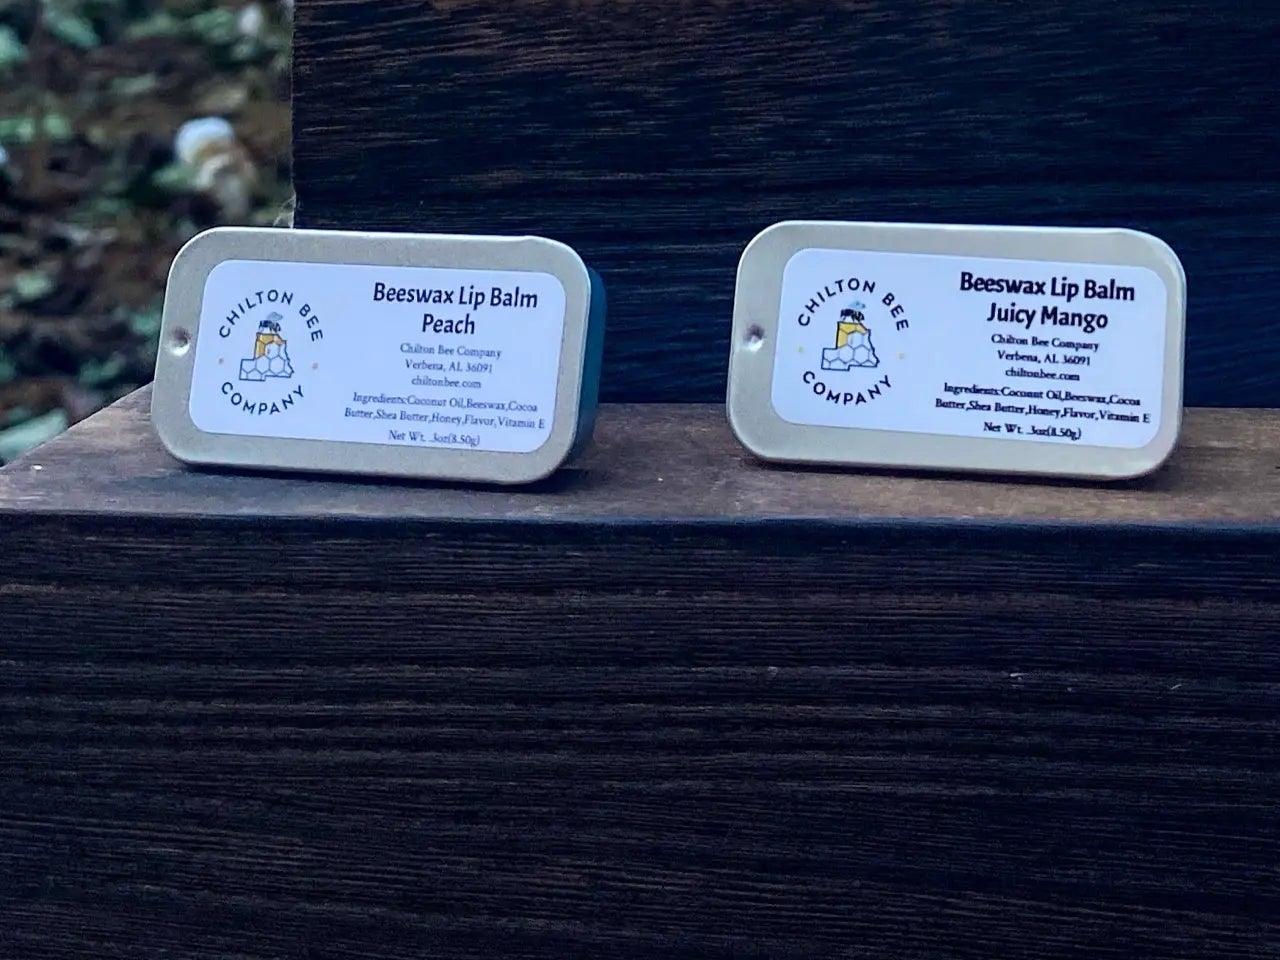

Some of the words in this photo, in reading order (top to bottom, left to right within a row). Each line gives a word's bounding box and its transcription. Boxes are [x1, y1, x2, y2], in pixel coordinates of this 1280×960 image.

[373, 283, 453, 304] Beeswax
[458, 285, 485, 307] Lip
[490, 287, 537, 307] Balm
[960, 272, 1046, 295] Beeswax
[1050, 276, 1079, 299] Lip
[1084, 279, 1135, 302] Balm
[219, 289, 293, 339] CHILTON
[299, 304, 323, 342] BEE
[798, 278, 875, 327] CHILTON
[882, 292, 909, 331] BEE
[422, 314, 475, 335] Peach
[987, 304, 1036, 329] Juicy
[1040, 307, 1108, 332] Mango
[400, 343, 434, 354] Chilton
[437, 344, 454, 356] Bee
[457, 346, 501, 359] Company
[991, 334, 1028, 346] Chilton
[1031, 337, 1048, 348] Bee
[1051, 338, 1099, 352] Company
[221, 382, 304, 415] COMPANY
[802, 370, 892, 405] COMPANY
[389, 430, 406, 441] Net
[538, 418, 544, 429] E
[984, 421, 1002, 433] Net
